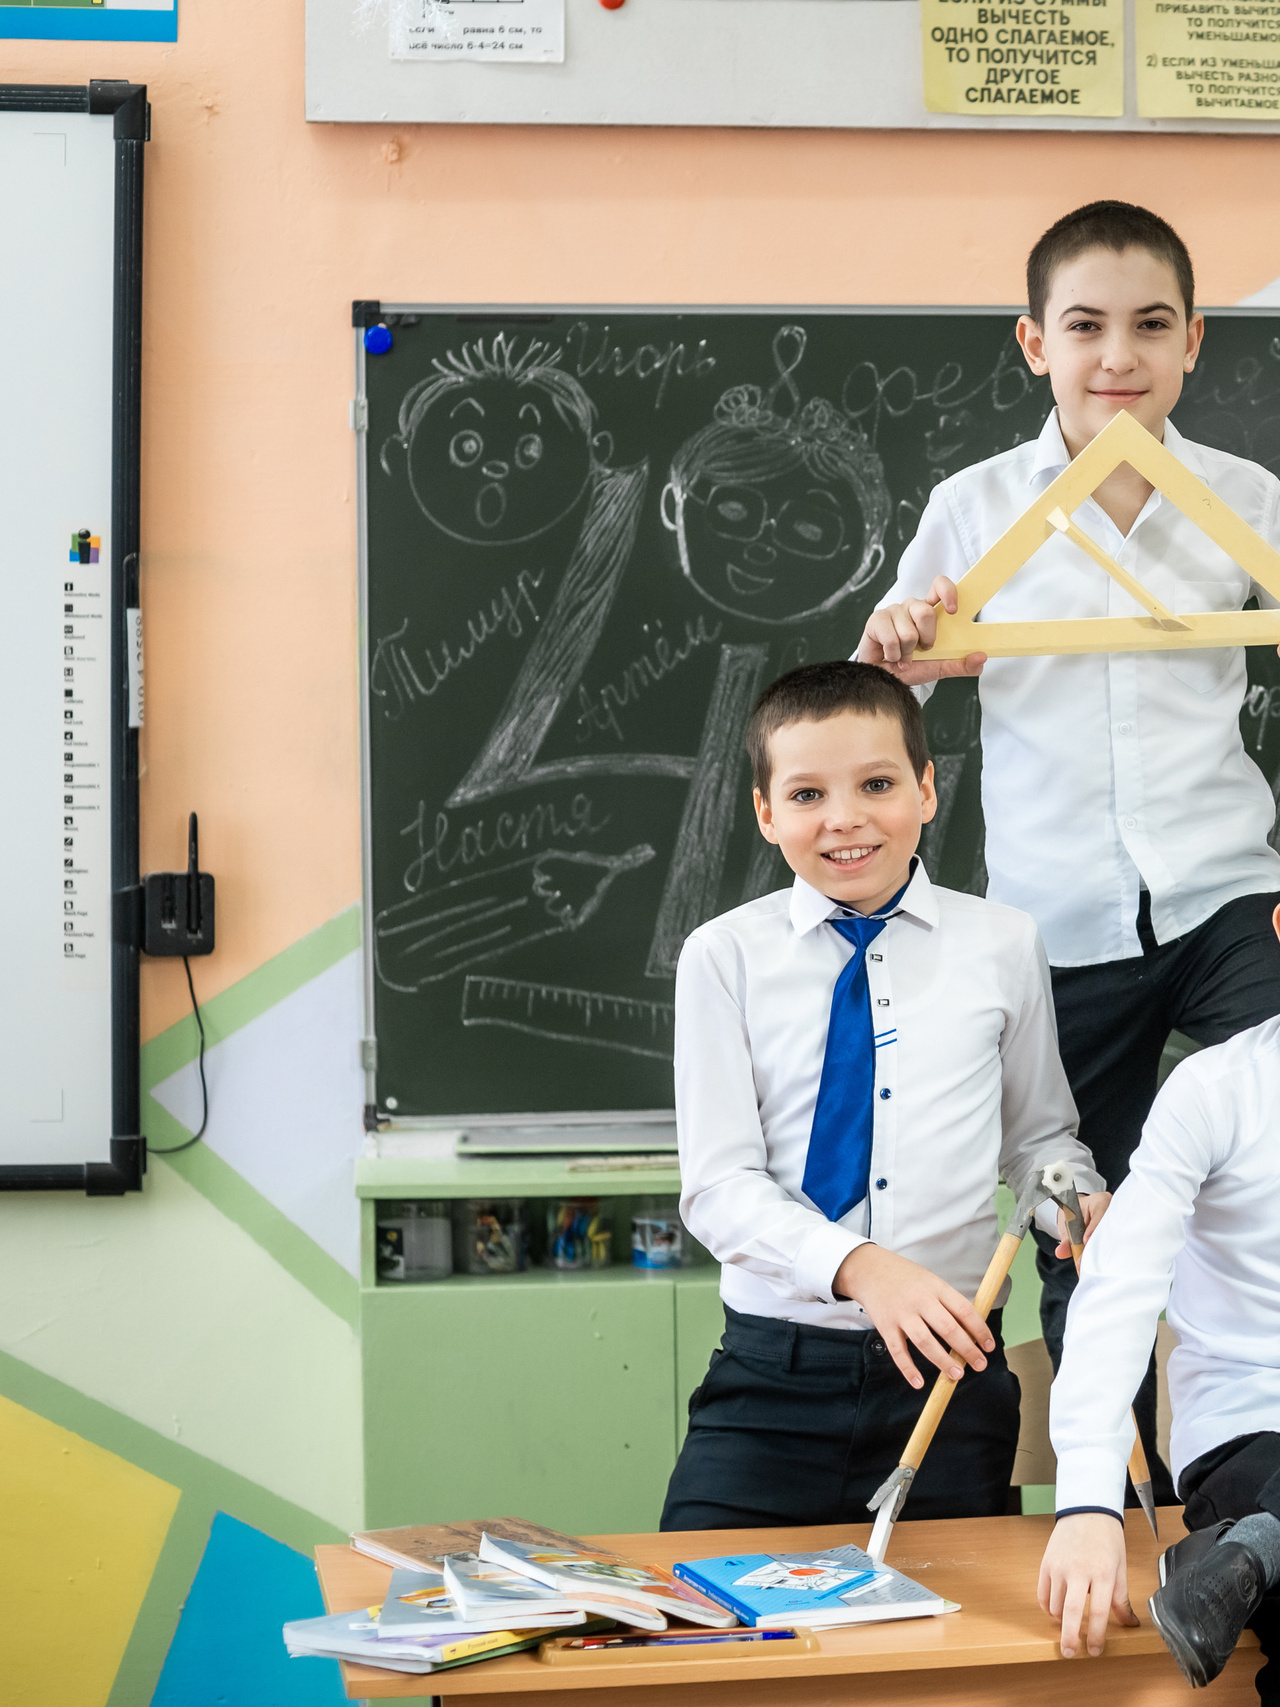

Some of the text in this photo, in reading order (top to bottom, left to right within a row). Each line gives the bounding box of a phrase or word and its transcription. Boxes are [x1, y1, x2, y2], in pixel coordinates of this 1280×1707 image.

[1155, 3, 1230, 15] ПРИБАВИТЬ
[977, 8, 1070, 25] ВЫЧЕСТЬ
[1187, 17, 1203, 27] ТО
[931, 27, 1115, 47] ОДНО СЛАГАЕМОЕ,
[945, 47, 1097, 65] ТО ПОЛУЧИТСЯ
[1162, 57, 1196, 67] ЕСЛИ
[1201, 57, 1216, 67] ИЗ
[985, 68, 1061, 85] ДРУГОЕ
[1176, 70, 1234, 81] ВЫЧЕСТЬ
[1188, 84, 1204, 94] ТО
[965, 87, 1081, 104] СЛАГАЕМОЕ
[1196, 97, 1280, 109] ВЫЧИТАЕМОЕ
